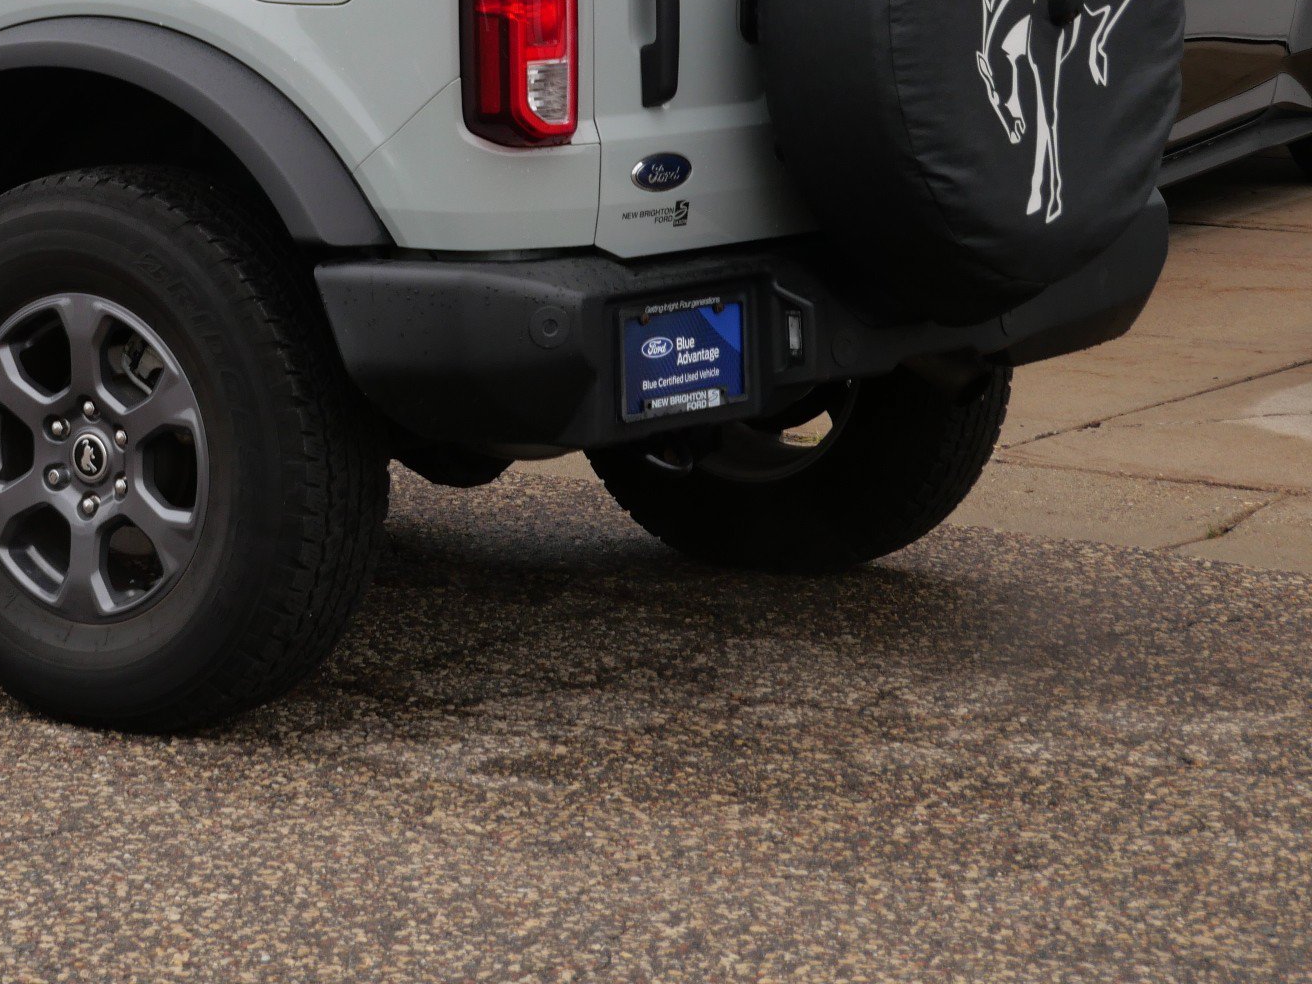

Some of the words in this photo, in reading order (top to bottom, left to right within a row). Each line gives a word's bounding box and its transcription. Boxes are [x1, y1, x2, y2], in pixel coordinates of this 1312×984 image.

[648, 163, 680, 184] Ford
[622, 212, 638, 221] NEW
[639, 207, 674, 219] BRIGHTON
[654, 215, 673, 224] FORD
[648, 339, 667, 356] Ford
[676, 337, 695, 351] Blue
[677, 347, 720, 366] Advantage
[642, 380, 657, 390] Blue
[658, 374, 684, 387] Certified
[685, 371, 699, 382] Used
[699, 367, 720, 379] Vehicle
[651, 398, 668, 408] NEW
[670, 391, 707, 405] BRIGHTON
[686, 400, 707, 411] FORD
